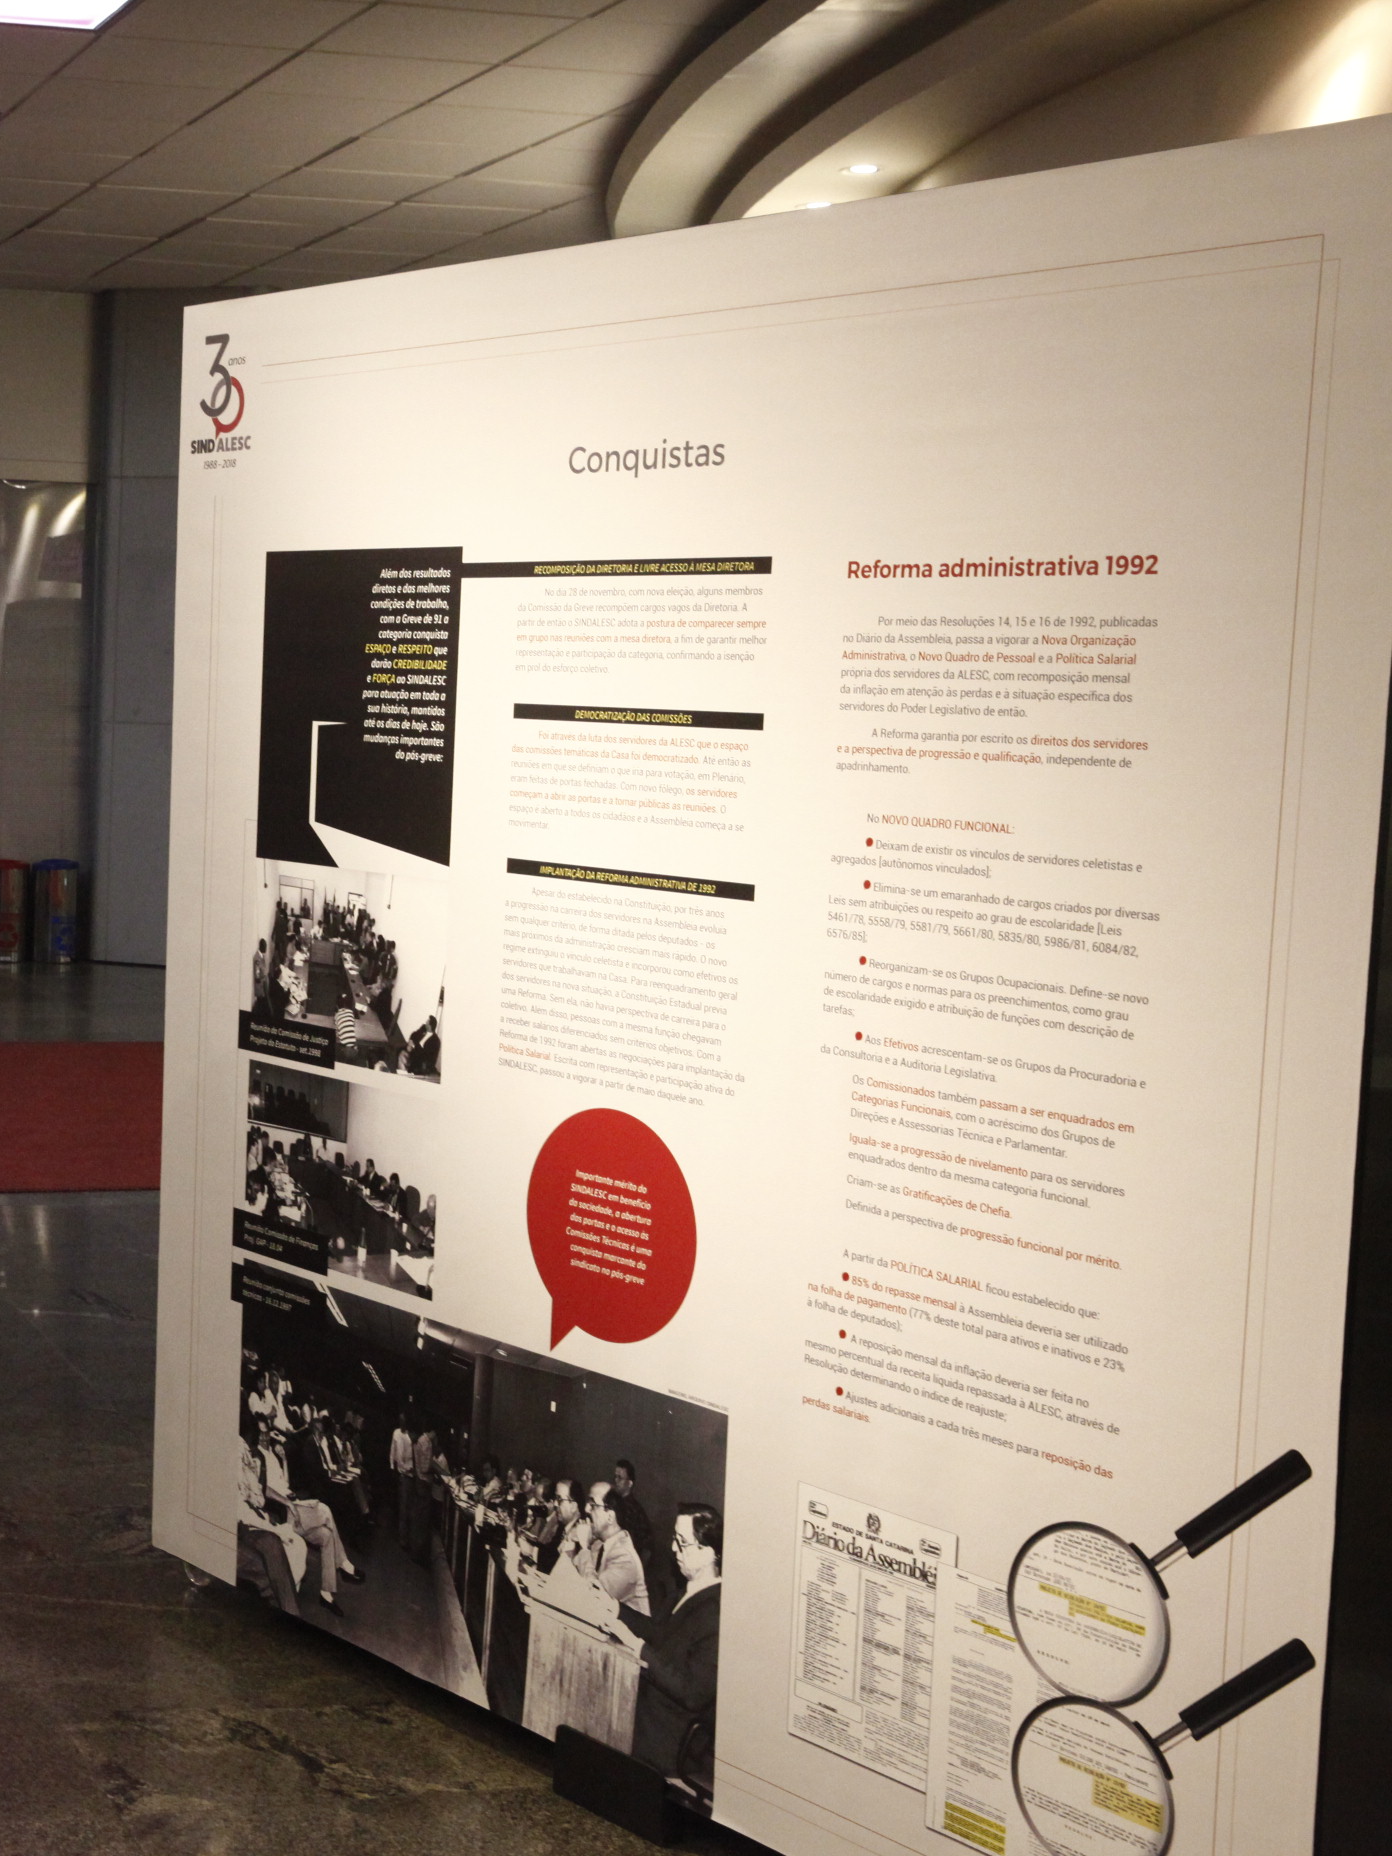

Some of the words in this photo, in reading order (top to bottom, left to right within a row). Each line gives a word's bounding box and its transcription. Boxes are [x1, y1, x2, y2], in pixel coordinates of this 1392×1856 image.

[228, 356, 246, 366] anos
[568, 438, 726, 479] Conquistas
[586, 564, 596, 574] DA
[596, 564, 633, 573] DIRETORIA
[634, 564, 638, 573] E
[639, 563, 659, 573] LIVRE
[660, 563, 689, 572] ACESSO
[689, 562, 695, 571] À
[695, 562, 716, 571] MESA
[717, 562, 754, 571] DIRETORA
[847, 559, 933, 579] Reforma
[938, 556, 1099, 578] administrativa
[1105, 554, 1159, 575] 1992
[380, 568, 398, 578] Além
[399, 568, 412, 578] dos
[372, 583, 396, 593] diretos
[397, 585, 402, 593] e
[402, 583, 416, 593] das
[416, 583, 450, 593] melhores
[370, 599, 405, 609] condições
[405, 598, 415, 609] de
[415, 598, 450, 609] trabalho,
[401, 614, 422, 624] Greve
[423, 613, 432, 624] de
[433, 614, 442, 624] 91
[443, 616, 449, 624] a
[878, 616, 893, 626] Por
[895, 618, 918, 626] meio
[920, 616, 937, 626] das
[939, 616, 995, 627] Resoluções
[999, 616, 1014, 627] 14,
[1016, 616, 1027, 627] 15
[1029, 619, 1036, 627] e
[1039, 616, 1051, 627] 16
[1053, 616, 1066, 627] de
[1070, 616, 1098, 628] 1992,
[1099, 616, 1158, 627] publicadas
[378, 629, 412, 641] categoria
[412, 629, 448, 640] conquista
[365, 643, 391, 654] ESPAÇO
[391, 646, 397, 654] e
[397, 644, 433, 654] RESPEITO
[433, 646, 448, 656] que
[371, 658, 392, 668] darão
[366, 675, 371, 683] e
[372, 673, 395, 684] FORÇA
[396, 676, 406, 684] ao
[407, 674, 446, 685] SINDALESC
[574, 710, 635, 721] DEMOCRATIZAÇÃO
[636, 712, 650, 722] DAS
[651, 713, 692, 724] COMISSÕES
[867, 813, 879, 823] No
[881, 814, 909, 825] NOVO
[911, 816, 952, 829] QUADRO
[954, 820, 1016, 834] FUNCIONAL:
[585, 870, 595, 879] DA
[596, 872, 629, 883] REFORMA
[687, 882, 697, 892] DE
[699, 883, 716, 894] 1992
[843, 1249, 849, 1258] A
[851, 1252, 874, 1264] partir
[877, 1257, 888, 1268] da
[890, 1260, 934, 1279] POLÍTICA
[936, 1271, 981, 1291] SALARIAL
[985, 1282, 1010, 1298] ficou
[1012, 1292, 1076, 1314] estabelecido
[1077, 1308, 1101, 1320] que:
[802, 1520, 845, 1552] Diário
[846, 1537, 863, 1559] da
[865, 1544, 937, 1586] Assembléi
